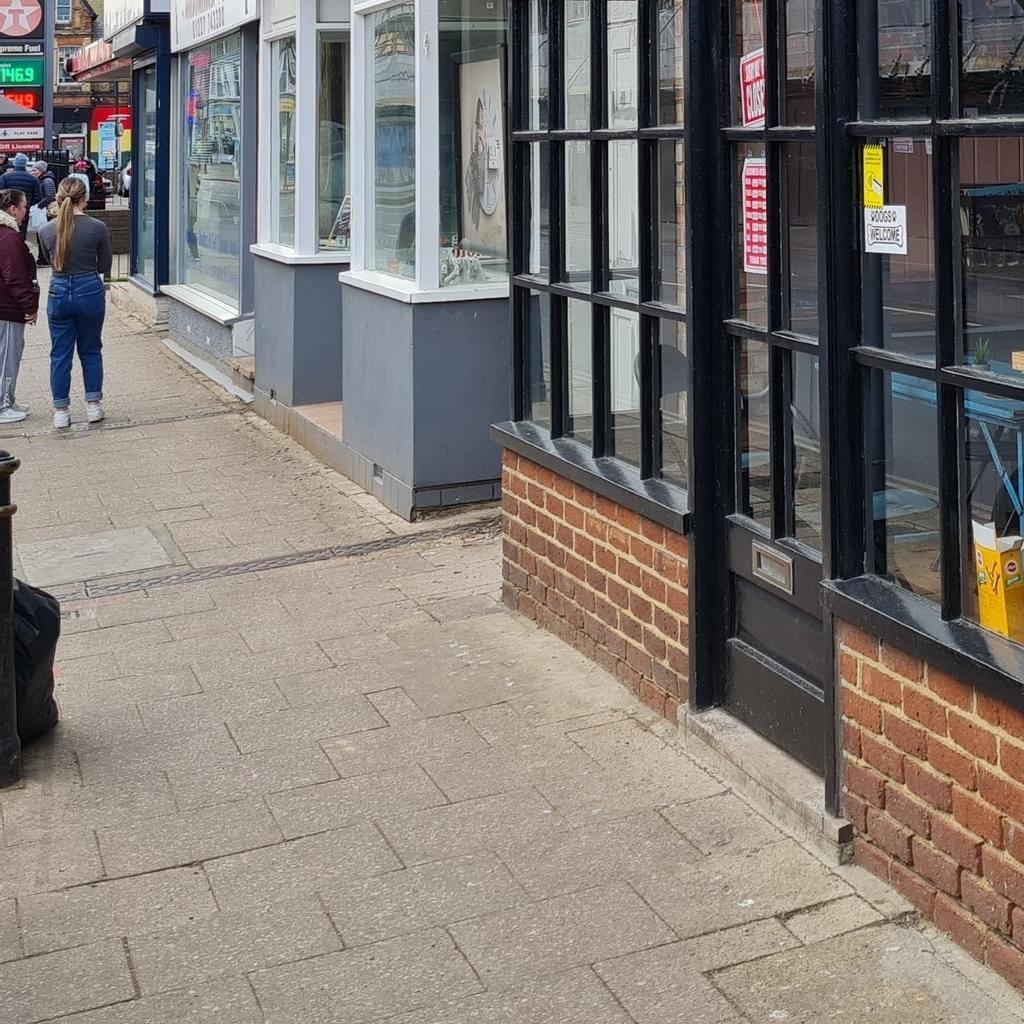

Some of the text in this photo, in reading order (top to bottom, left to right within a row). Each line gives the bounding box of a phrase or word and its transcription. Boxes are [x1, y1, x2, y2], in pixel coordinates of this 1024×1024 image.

[24, 44, 41, 53] Fuel
[874, 210, 893, 223] DOGS
[869, 227, 901, 242] WELCOME
